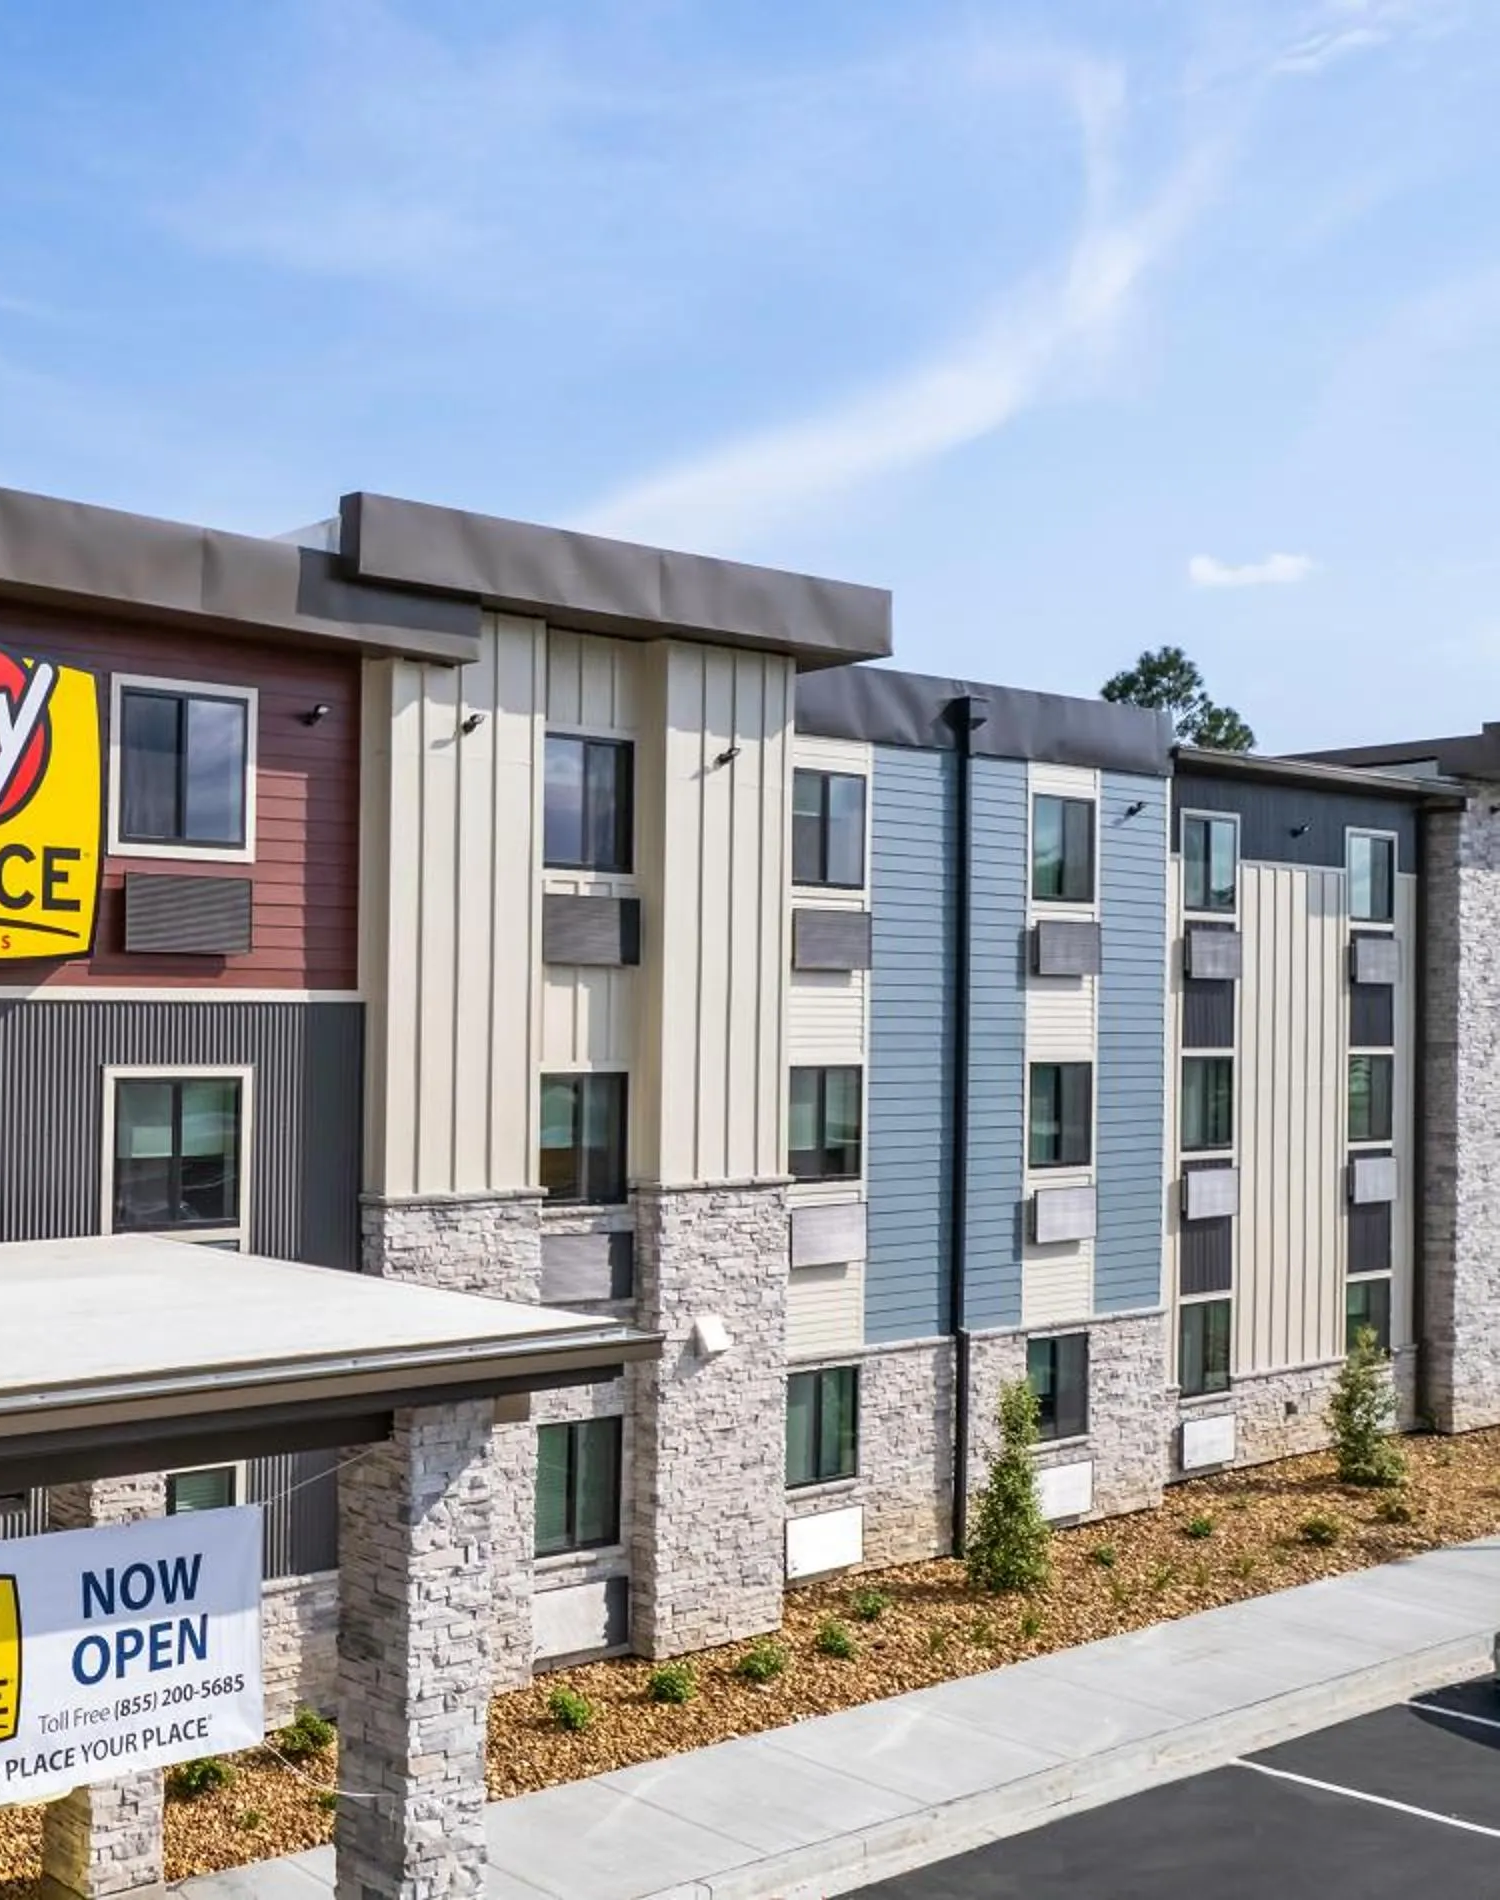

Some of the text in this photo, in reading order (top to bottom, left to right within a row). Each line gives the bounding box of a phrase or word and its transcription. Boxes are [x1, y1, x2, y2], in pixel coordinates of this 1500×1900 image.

[81, 1553, 203, 1619] NOW
[71, 1613, 209, 1685] OPEN
[38, 1673, 245, 1735] Toll Free (855) 200-5685
[5, 1747, 76, 1782] PLACE
[80, 1731, 138, 1763] YOUR
[142, 1716, 209, 1750] PLACE
